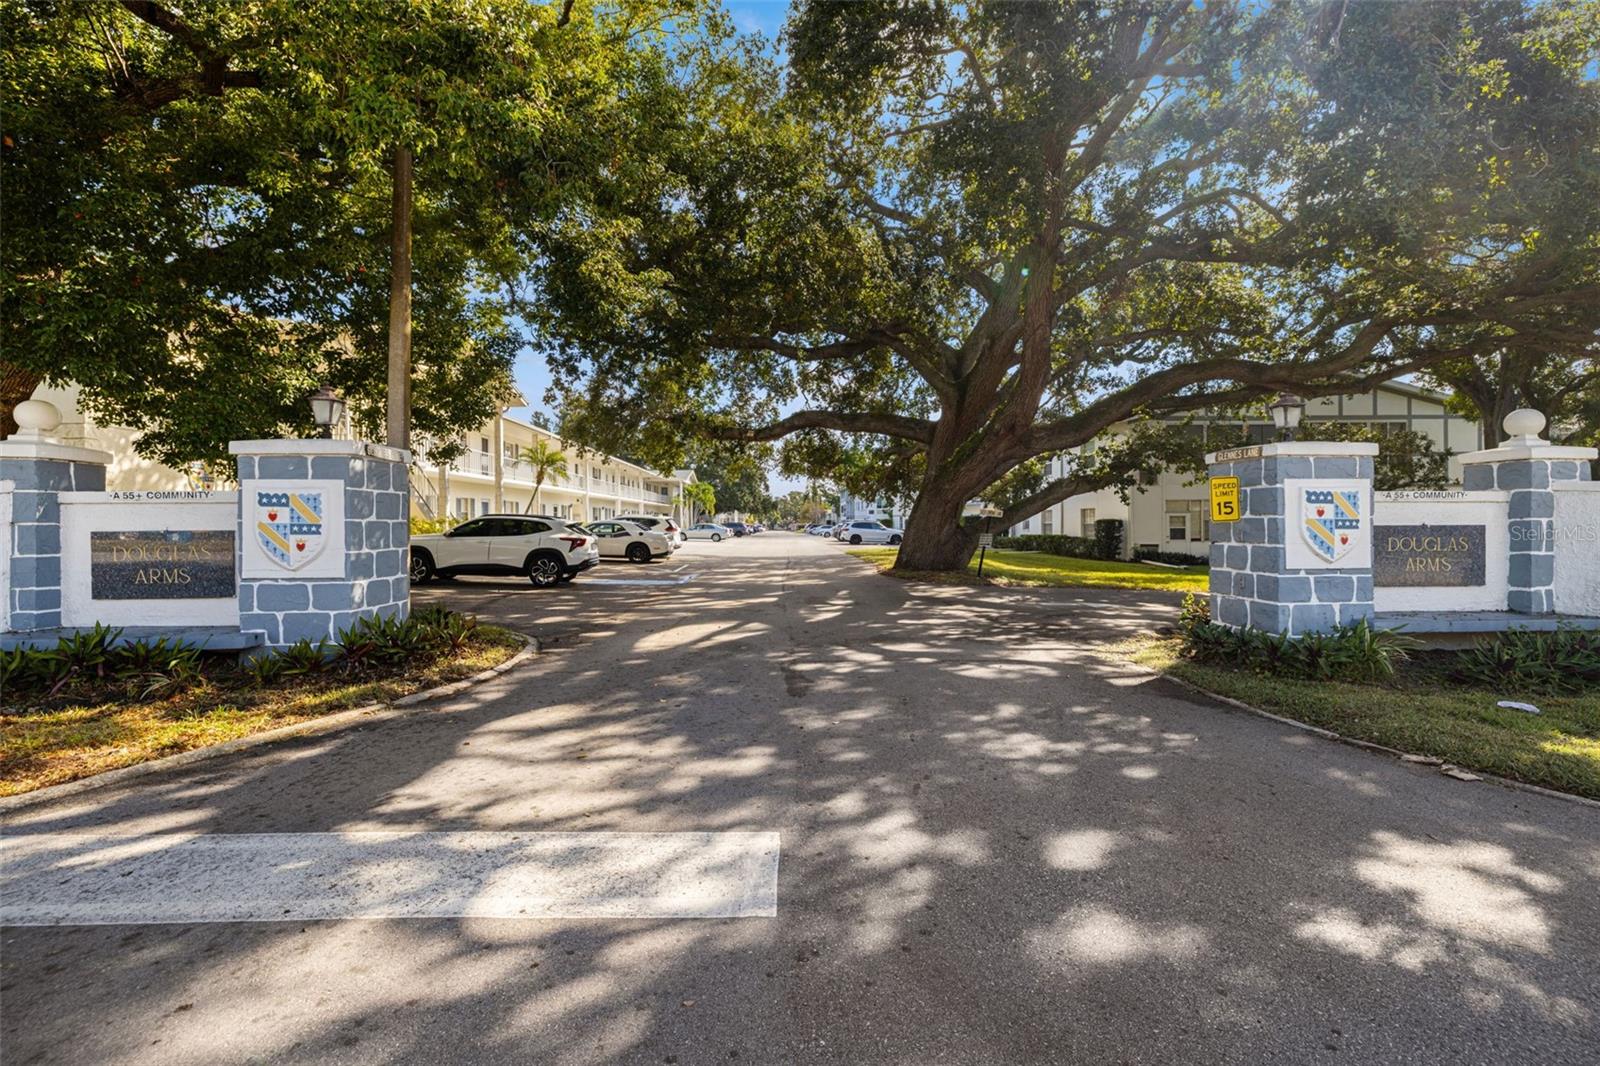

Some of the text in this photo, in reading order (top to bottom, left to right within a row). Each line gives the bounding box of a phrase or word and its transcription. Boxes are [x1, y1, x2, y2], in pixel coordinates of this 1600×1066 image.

[1213, 482, 1237, 490] SPEED
[122, 491, 143, 500] 55+
[1394, 491, 1410, 499] 55+
[1216, 501, 1234, 516] 15
[1387, 536, 1469, 552] DOUGLAS
[112, 545, 212, 562] DOUGLAS
[1405, 557, 1452, 572] ARMS
[134, 568, 192, 585] ARMS
